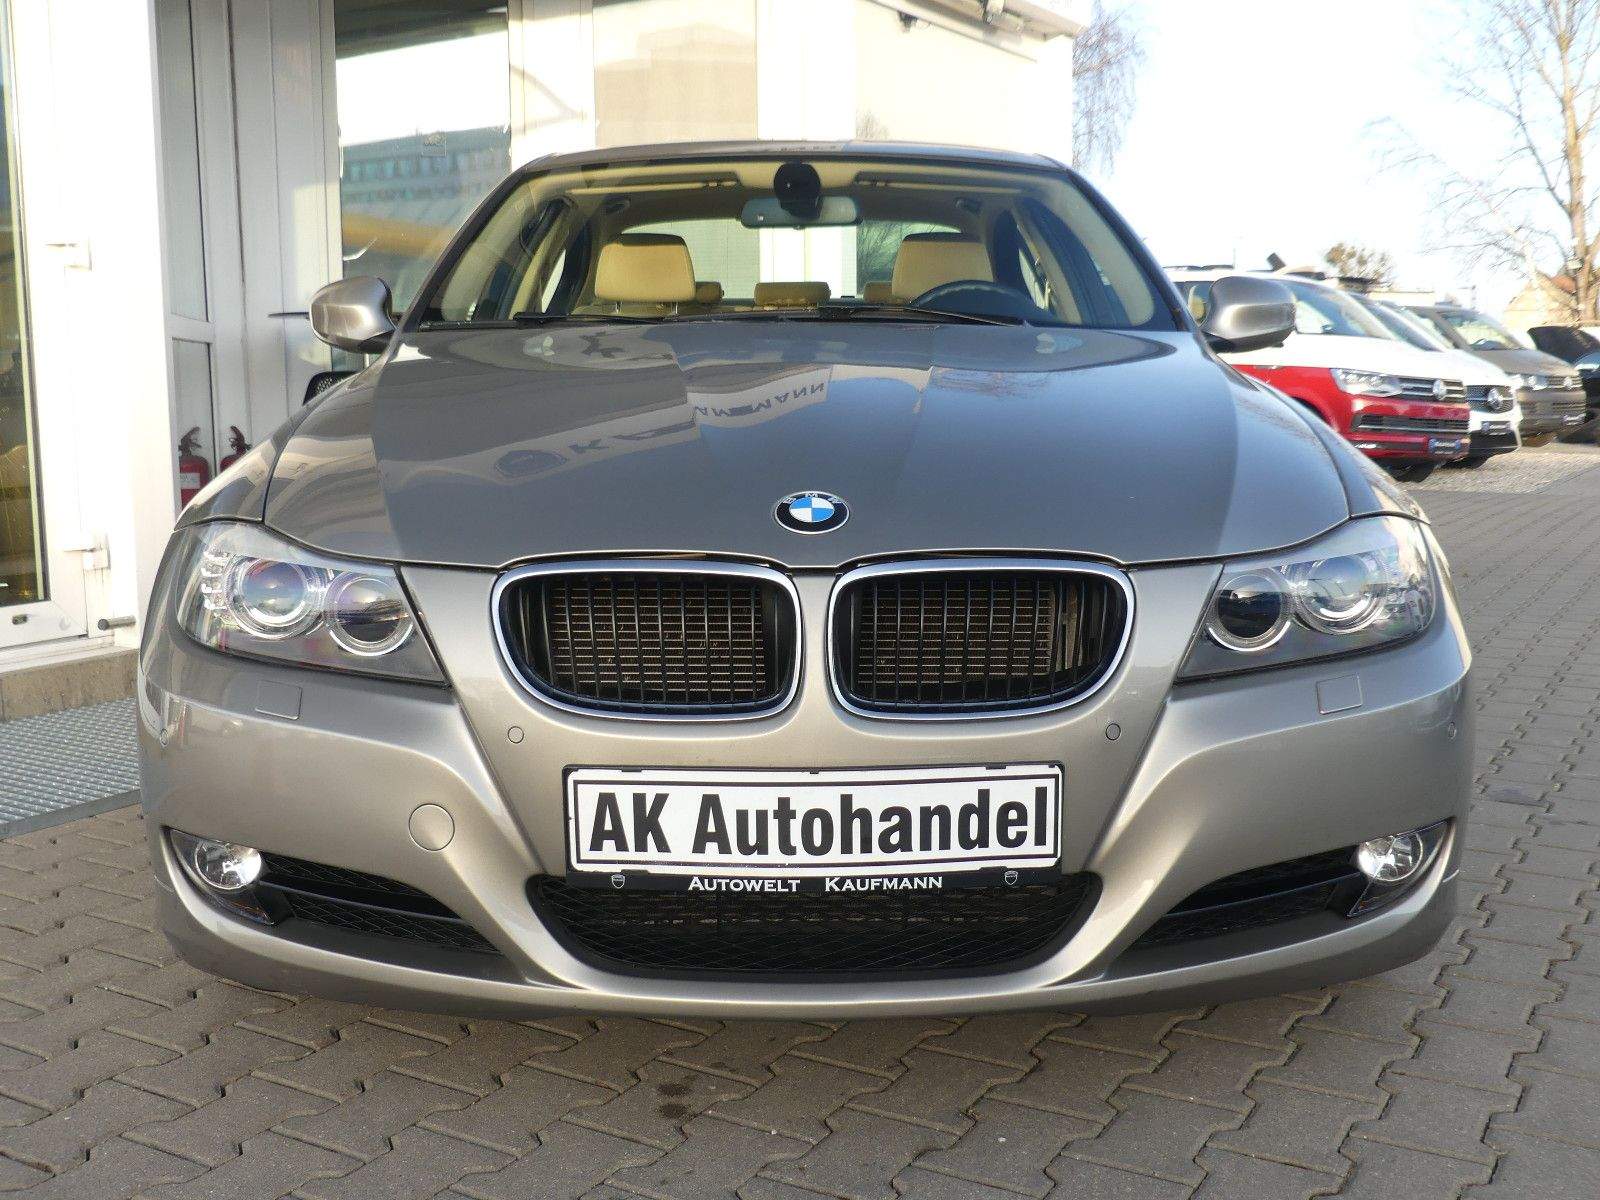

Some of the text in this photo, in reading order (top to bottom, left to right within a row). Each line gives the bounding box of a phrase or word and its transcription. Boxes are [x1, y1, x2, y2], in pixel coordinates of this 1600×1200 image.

[589, 787, 1048, 856] AK Autohandel
[687, 876, 943, 892] AUTOWELT KAUFMANN
